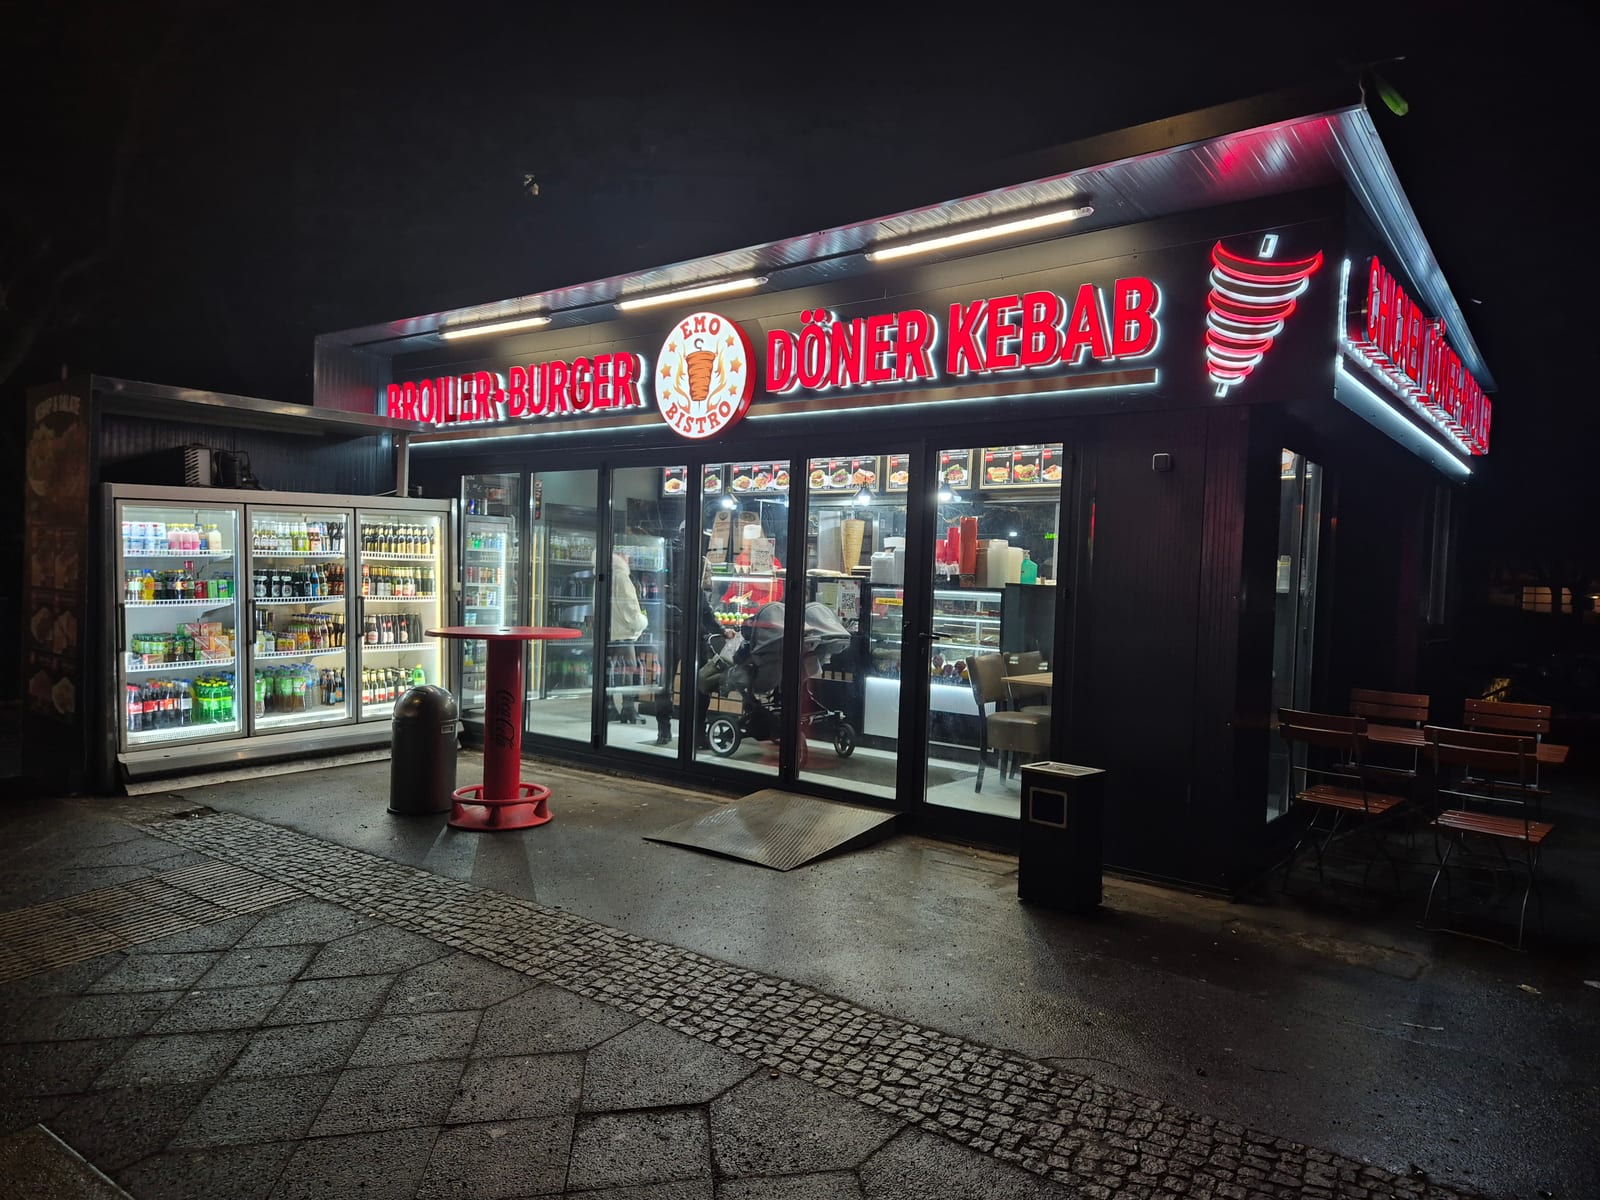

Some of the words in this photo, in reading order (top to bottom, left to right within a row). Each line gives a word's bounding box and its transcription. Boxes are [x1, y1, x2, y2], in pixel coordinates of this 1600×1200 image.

[680, 315, 721, 340] EMO
[766, 309, 936, 393] DÖNER
[946, 276, 1160, 374] KEBAB
[509, 352, 641, 417] BURGER
[665, 401, 731, 434] BISTRO
